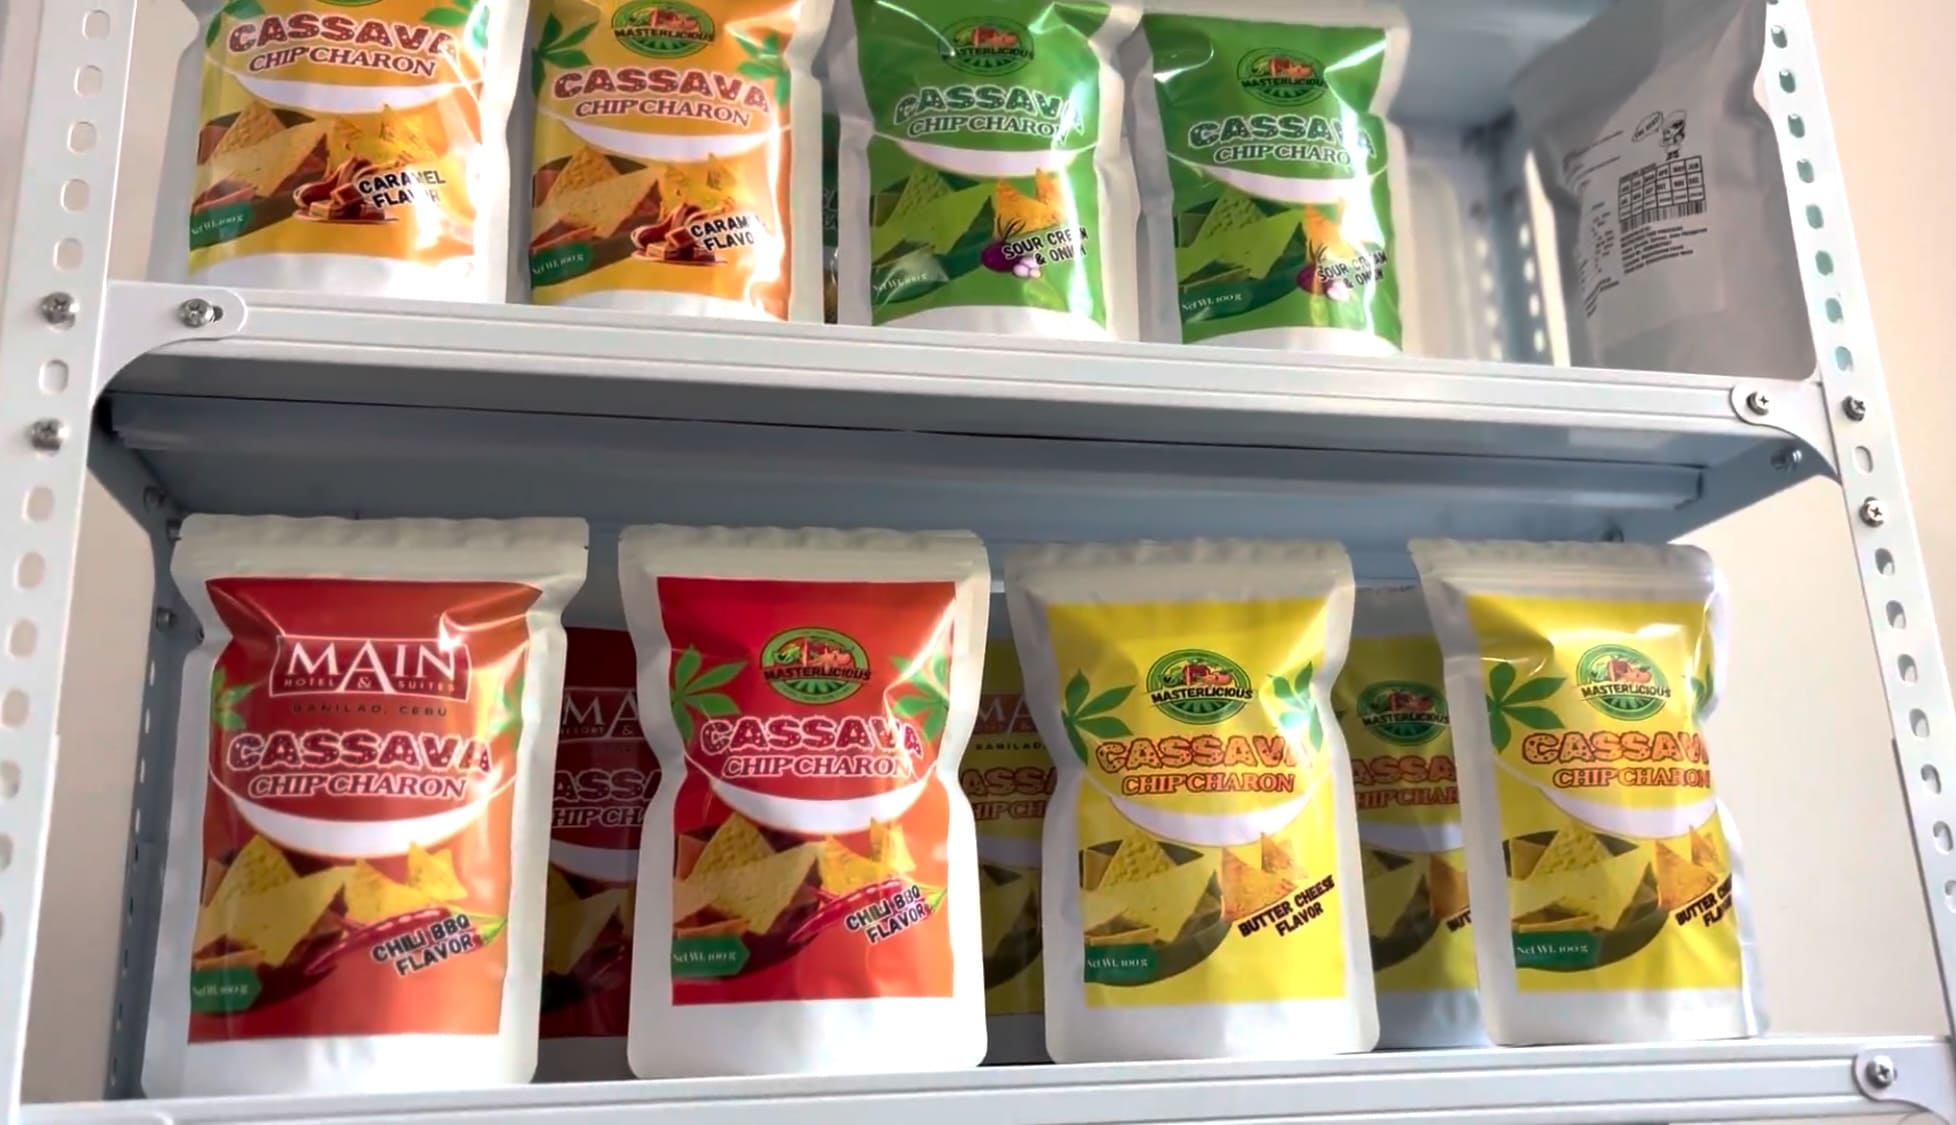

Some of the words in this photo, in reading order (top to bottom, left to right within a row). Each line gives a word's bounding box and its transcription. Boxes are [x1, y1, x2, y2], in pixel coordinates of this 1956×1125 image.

[554, 68, 770, 113] CASSAVA
[1213, 144, 1352, 169] CHIP'CHARO
[704, 232, 755, 251] FLAVO
[1003, 235, 1044, 259] SOUR
[1034, 252, 1047, 265] &
[1318, 262, 1350, 281] SOUR
[287, 639, 456, 694] MAIN
[764, 666, 872, 683] MASTERLICIOUS
[283, 678, 335, 688] HOTEL
[357, 676, 372, 689] &
[398, 680, 456, 692] SUITES
[1151, 687, 1254, 703] MASTERLICIOUS
[1580, 682, 1672, 699] MASTERLICIOUS
[399, 705, 448, 717] CEBU
[227, 730, 492, 774] CASSAVA
[846, 900, 892, 931] CHILI
[1238, 900, 1294, 938] BUTTER
[1294, 874, 1336, 909] CHEESE
[1275, 901, 1324, 937] FLAVOR
[1674, 892, 1718, 927] BUTTER
[867, 903, 926, 943] FLAVOR
[373, 930, 426, 962] CHILI
[396, 933, 473, 976] FLAVOR
